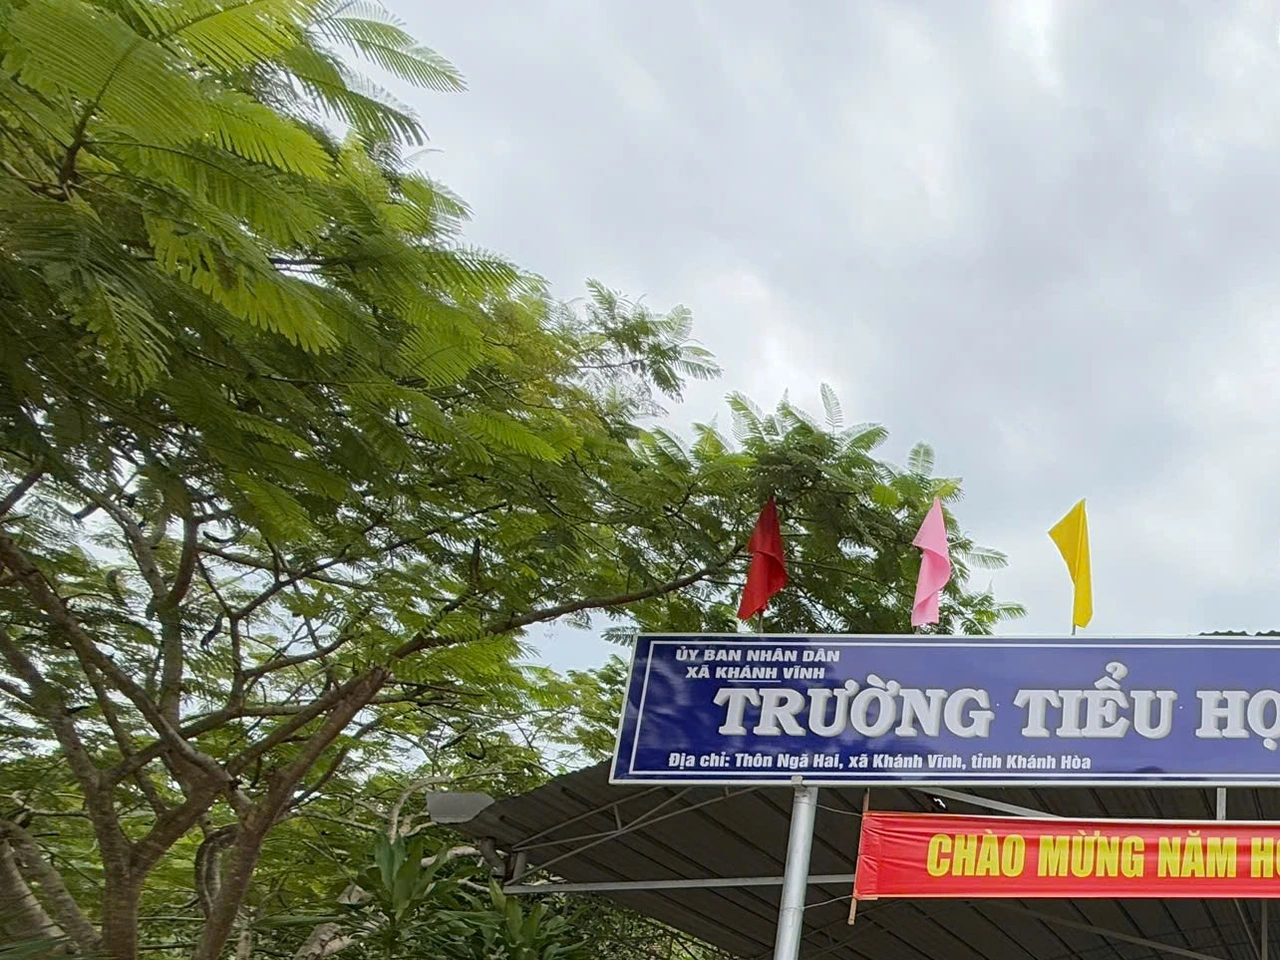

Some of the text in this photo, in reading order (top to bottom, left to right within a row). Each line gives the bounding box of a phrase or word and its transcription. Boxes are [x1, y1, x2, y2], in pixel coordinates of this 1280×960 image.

[675, 645, 841, 662] ỦY BAN NHÂN DÂN
[685, 664, 826, 680] XÃ KHÁNH VĨNH
[712, 673, 996, 739] TRƯỜNG
[1012, 661, 1178, 740] TIỂU
[668, 751, 1091, 770] Địa chỉ: Thôn Ngã Hai, xã Khánh Vĩnh, tỉnh Khánh Hòa
[926, 832, 1025, 879] CHÀO
[1037, 829, 1144, 879] MỪNG
[1157, 829, 1237, 879] NĂM
